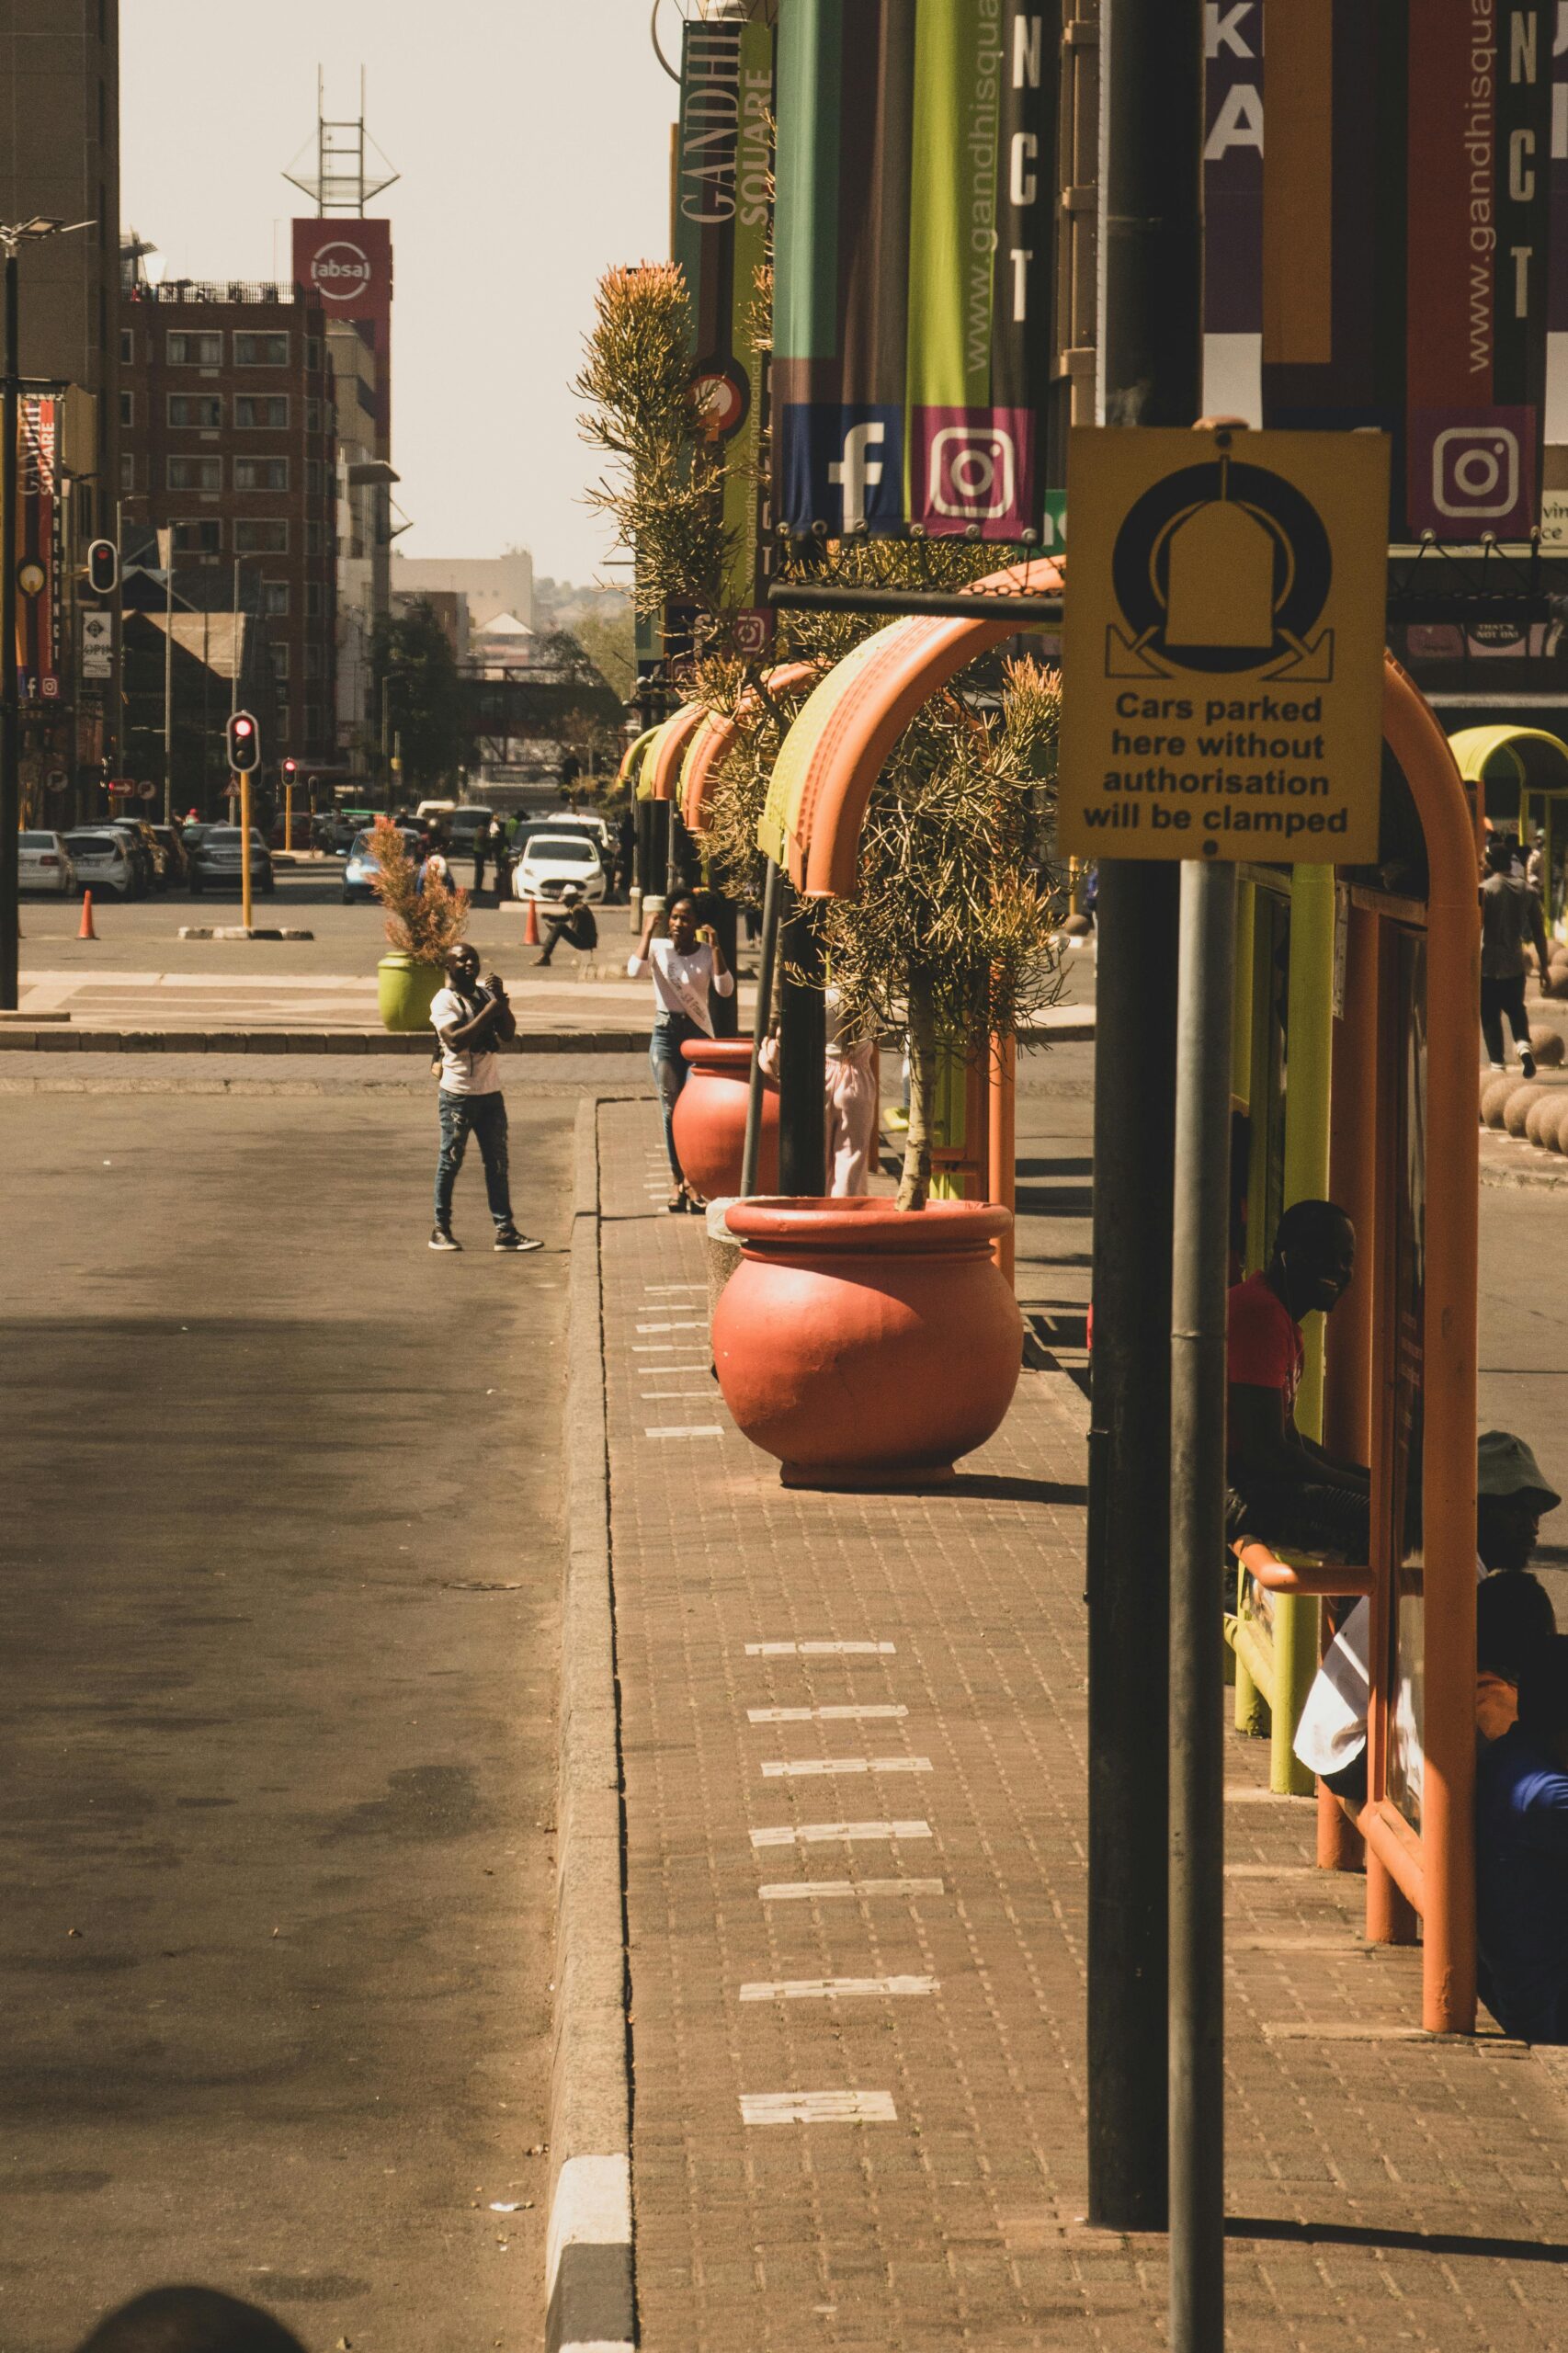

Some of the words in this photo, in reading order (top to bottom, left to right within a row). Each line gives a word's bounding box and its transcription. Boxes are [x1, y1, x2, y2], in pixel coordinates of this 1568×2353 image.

[681, 30, 742, 223] GANDHI
[740, 69, 773, 227] SQUARE
[318, 258, 363, 278] absa
[39, 423, 55, 495] SQUARE
[1115, 691, 1193, 720] Cars
[1205, 695, 1323, 726] parked
[1112, 730, 1186, 756] here
[1197, 732, 1324, 760] without
[1103, 767, 1330, 796] authorisation
[1083, 802, 1140, 828] will
[1152, 803, 1192, 829] be
[1203, 805, 1348, 839] clamped
